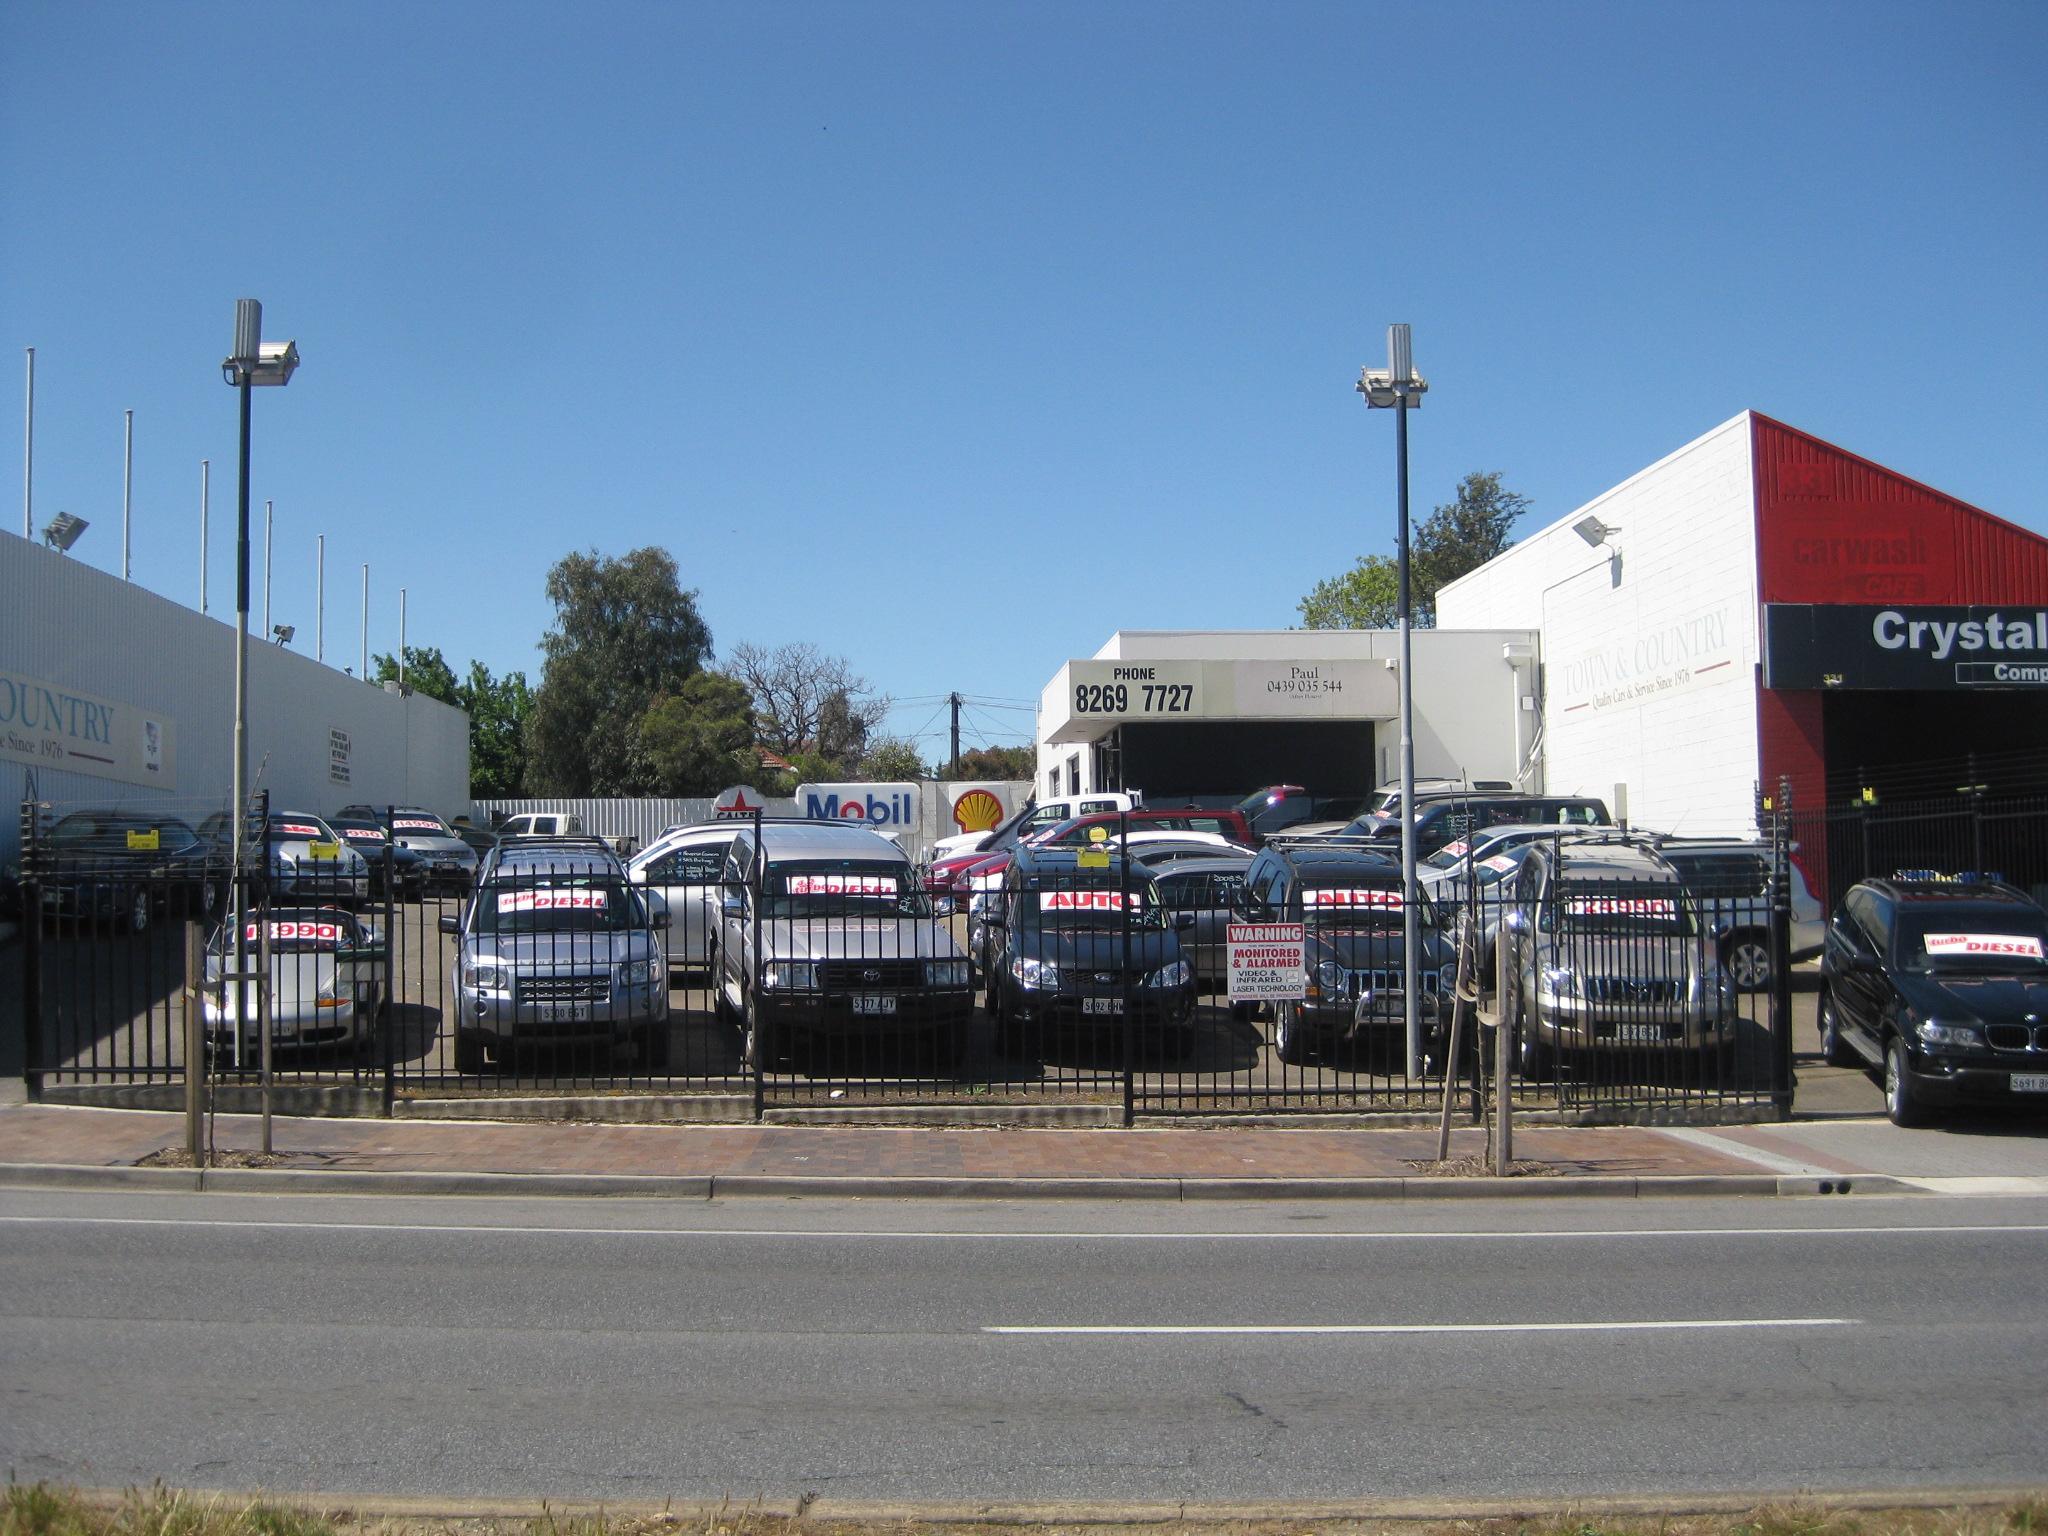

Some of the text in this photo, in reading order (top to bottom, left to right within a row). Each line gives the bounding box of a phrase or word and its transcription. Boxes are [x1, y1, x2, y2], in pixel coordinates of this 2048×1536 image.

[1634, 608, 1728, 675] COUNTRY
[1873, 611, 2048, 659] Crystal
[1114, 668, 1155, 680] PHONE
[1291, 667, 1319, 679] Paul
[1674, 668, 1691, 688] 1976
[1267, 680, 1343, 693] 0439 035 544
[1076, 685, 1193, 712] 8269 7727
[8, 731, 35, 754] Since
[40, 739, 63, 760] 1976
[807, 794, 910, 825] Mobil
[535, 897, 605, 907] DIESEL
[1048, 893, 1135, 908] AUTO
[1230, 927, 1302, 941] WARNING
[1234, 949, 1300, 958] MONITORED
[1966, 942, 2039, 955] DIESEL
[1233, 959, 1300, 968] & ALARMED
[1232, 985, 1302, 993] LASER TECHNOLOGY
